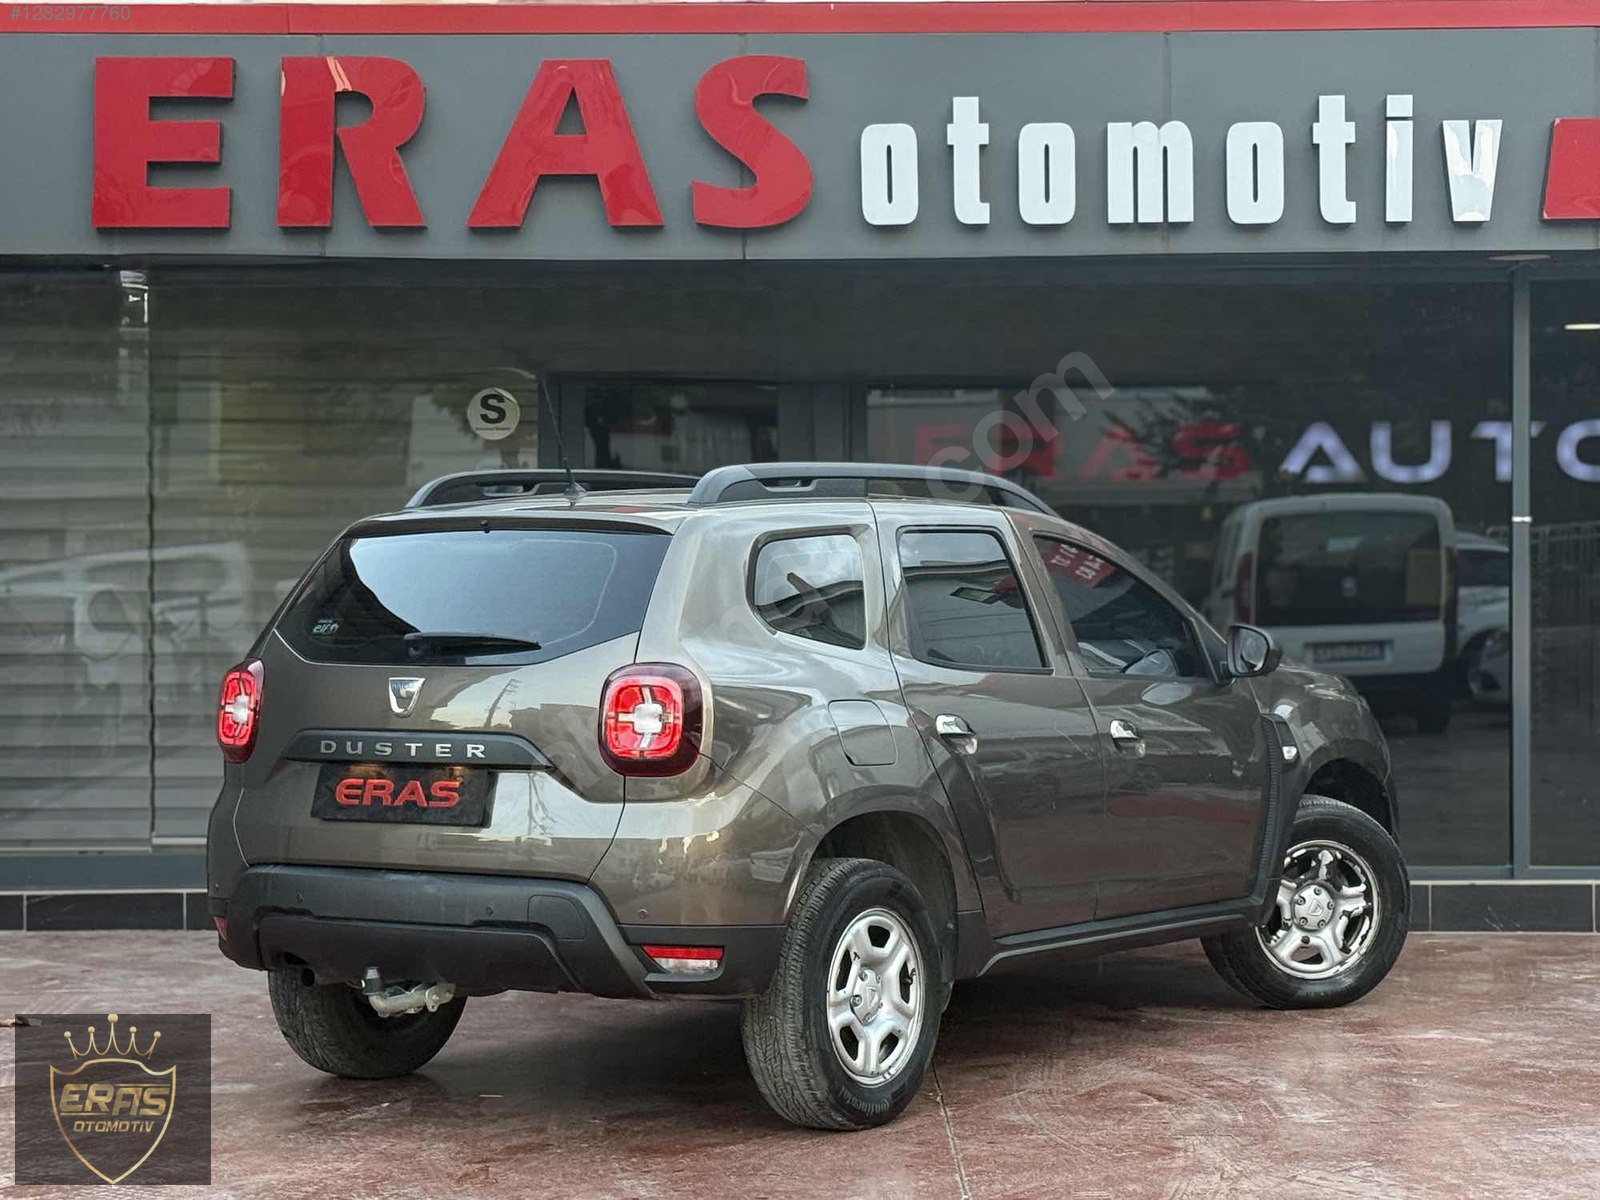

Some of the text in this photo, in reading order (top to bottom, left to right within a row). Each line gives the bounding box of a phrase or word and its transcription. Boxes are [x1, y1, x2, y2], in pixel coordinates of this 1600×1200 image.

[91, 54, 1503, 230] ERAS otomotiv
[479, 394, 507, 425] S
[320, 740, 486, 759] DUSTER
[335, 778, 460, 809] ERAS
